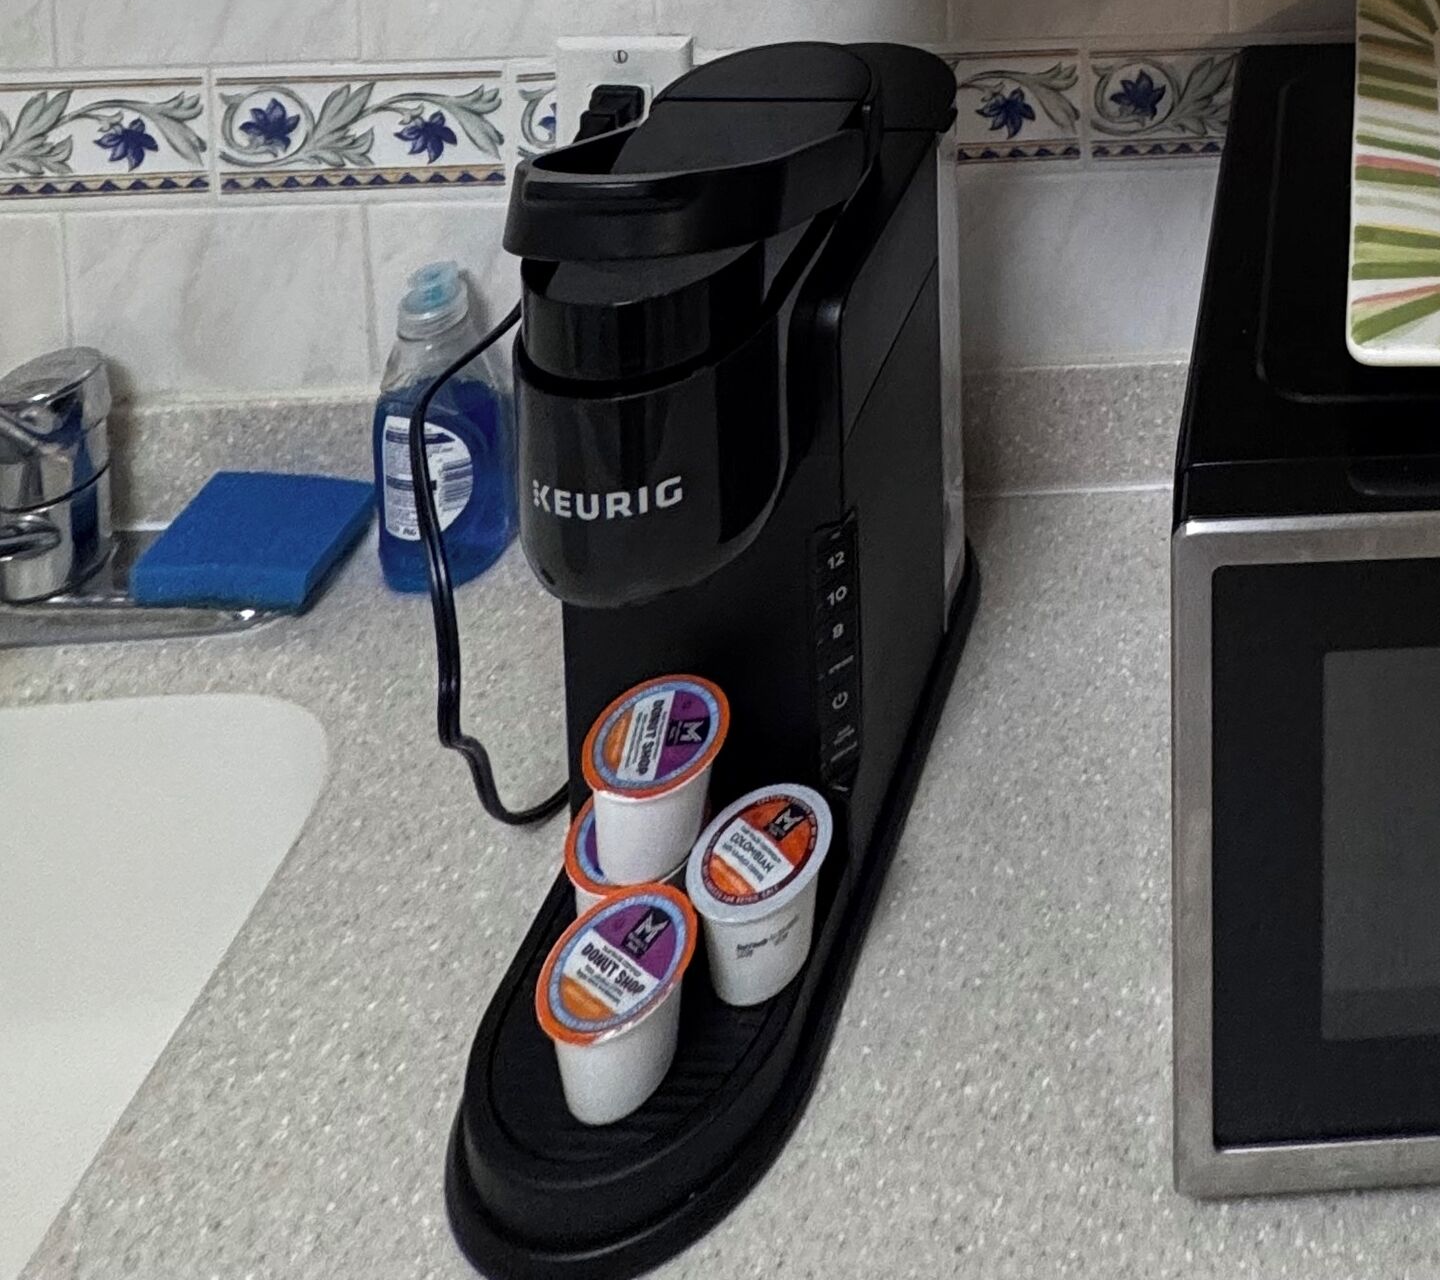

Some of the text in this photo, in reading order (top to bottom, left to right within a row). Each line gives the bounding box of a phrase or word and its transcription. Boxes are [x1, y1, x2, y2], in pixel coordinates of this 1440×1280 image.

[532, 475, 683, 521] KEURIG
[827, 551, 845, 570] 12
[826, 585, 848, 606] 10
[730, 833, 775, 872] COLOMBIAN
[581, 943, 619, 976] DONUT
[615, 969, 646, 995] SHOP
